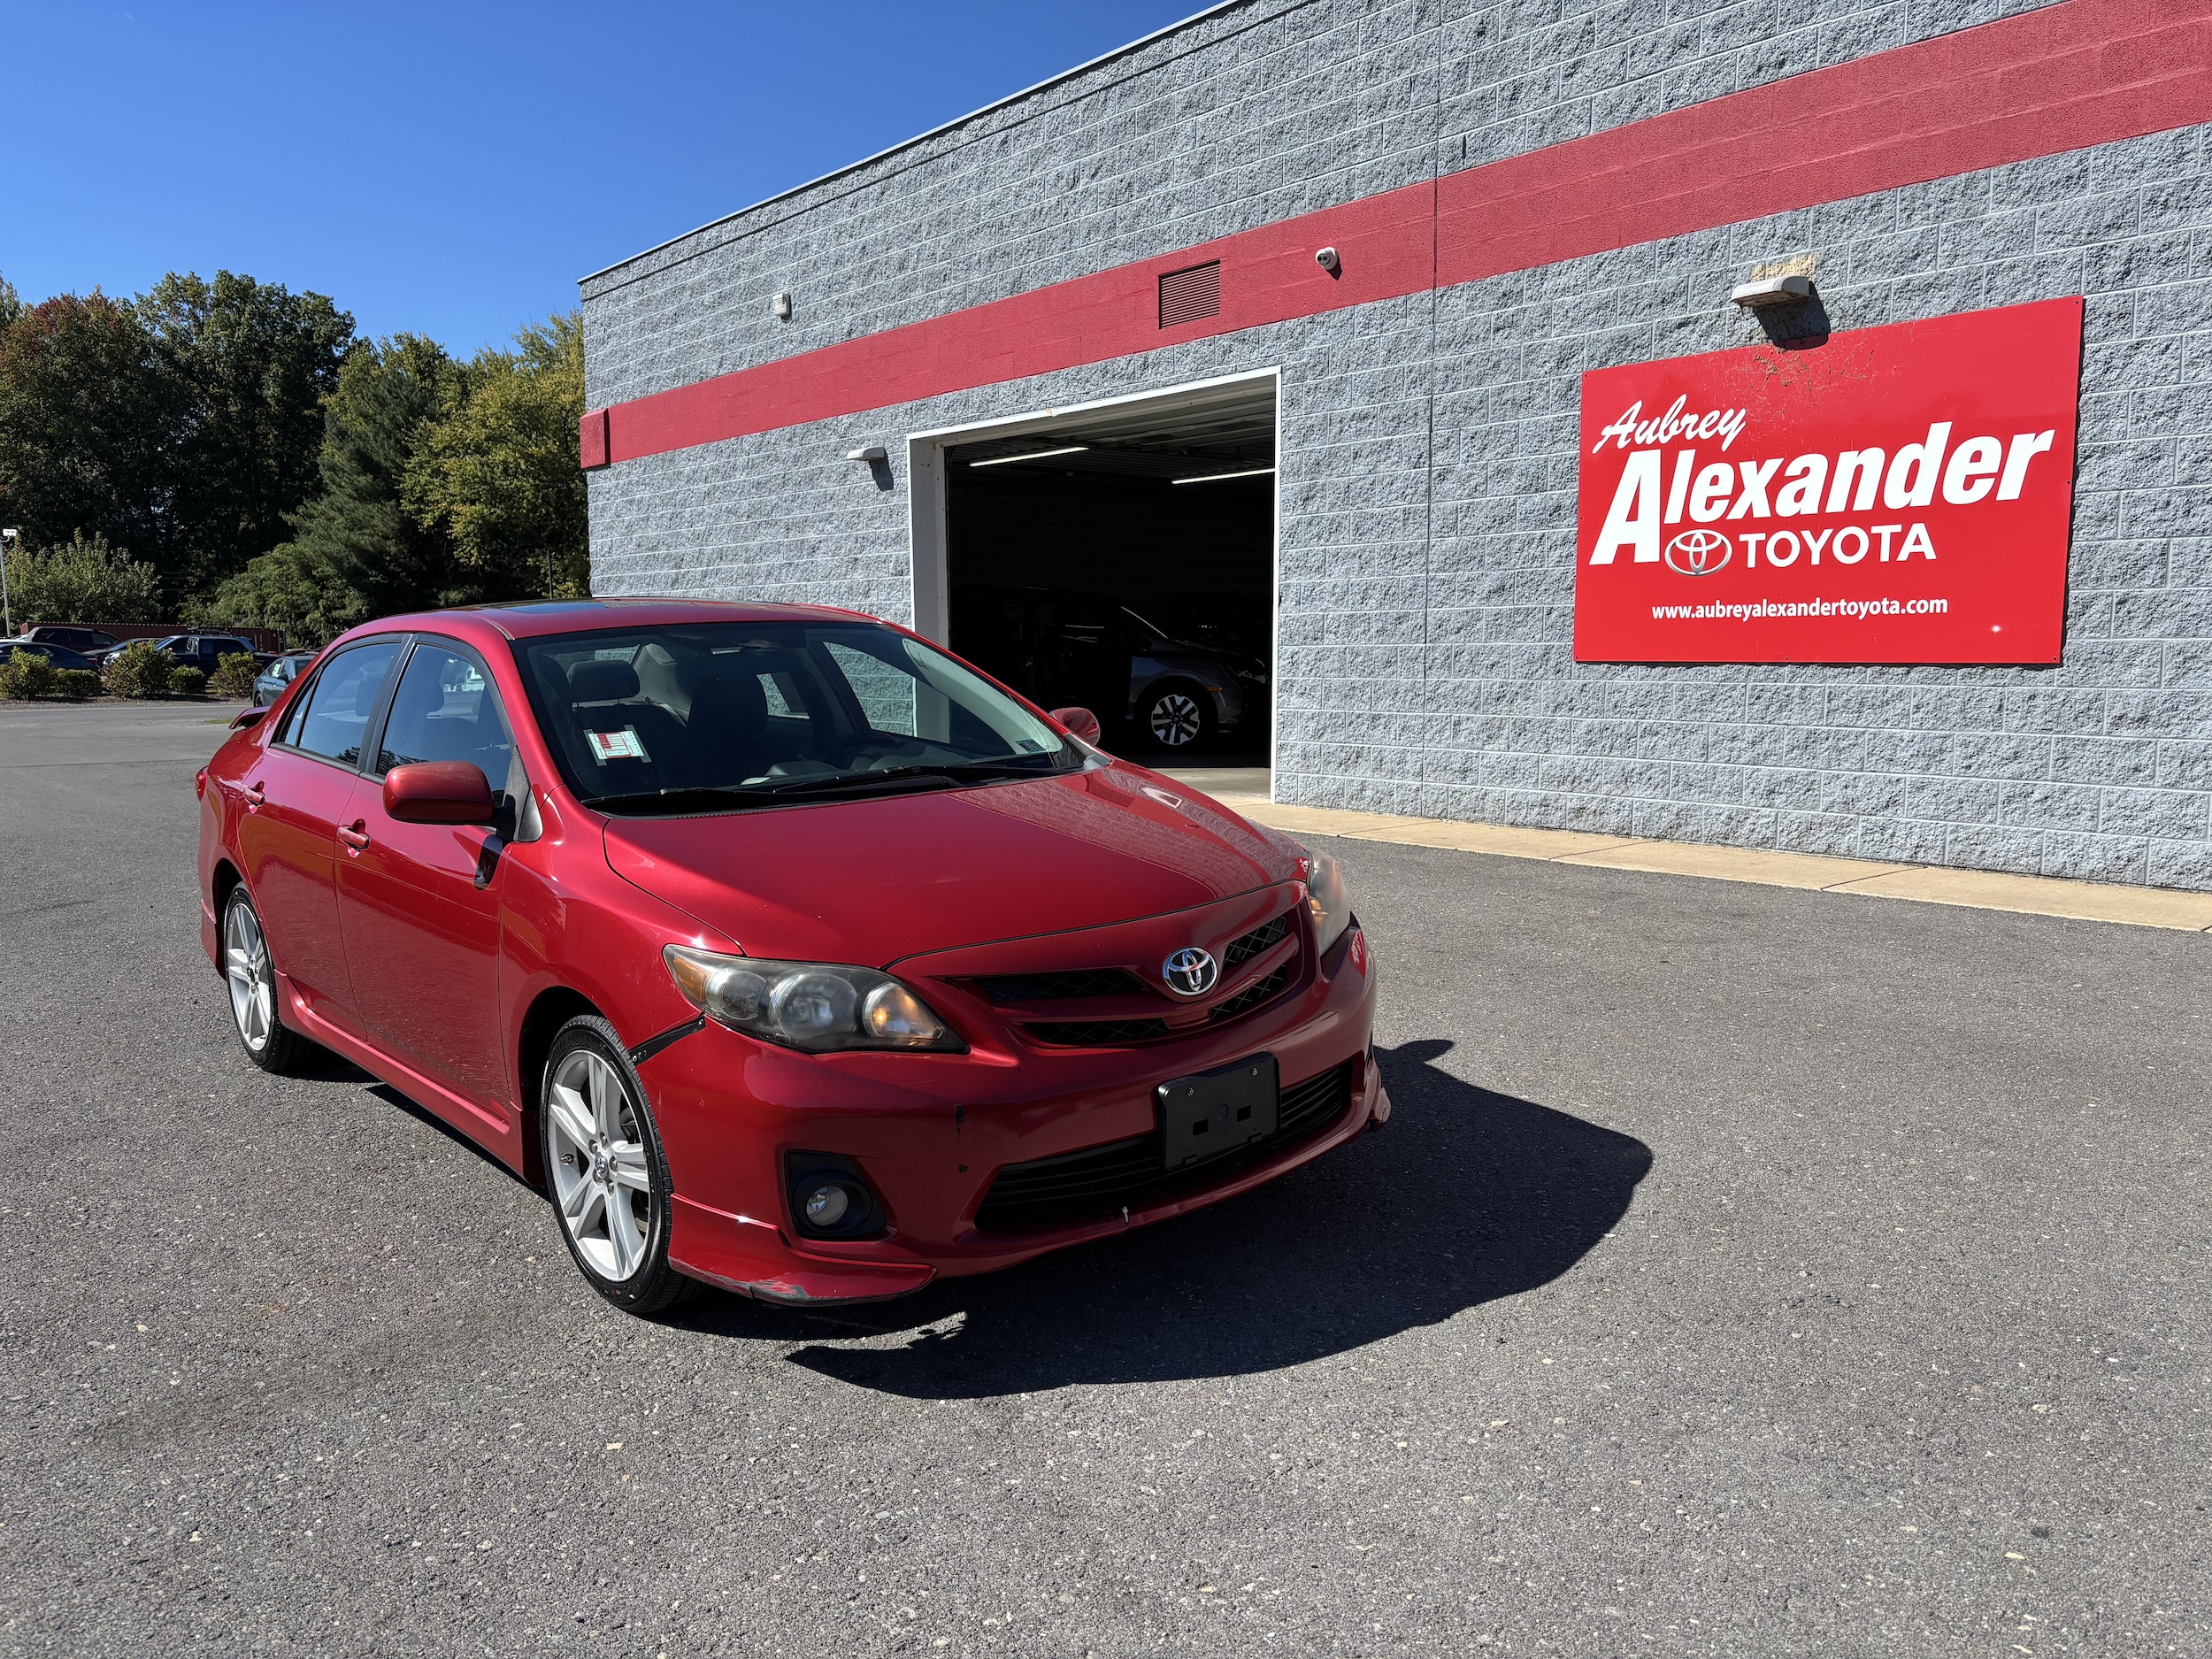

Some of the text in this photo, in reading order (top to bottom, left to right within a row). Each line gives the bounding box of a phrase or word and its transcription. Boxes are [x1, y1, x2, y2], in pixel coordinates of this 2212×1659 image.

[1592, 393, 1747, 454] Aubrey
[1589, 420, 2055, 565] Alexander
[1739, 522, 1938, 568] TOYOTA
[1651, 596, 1948, 622] www.aubreyalexandertoyota.com
